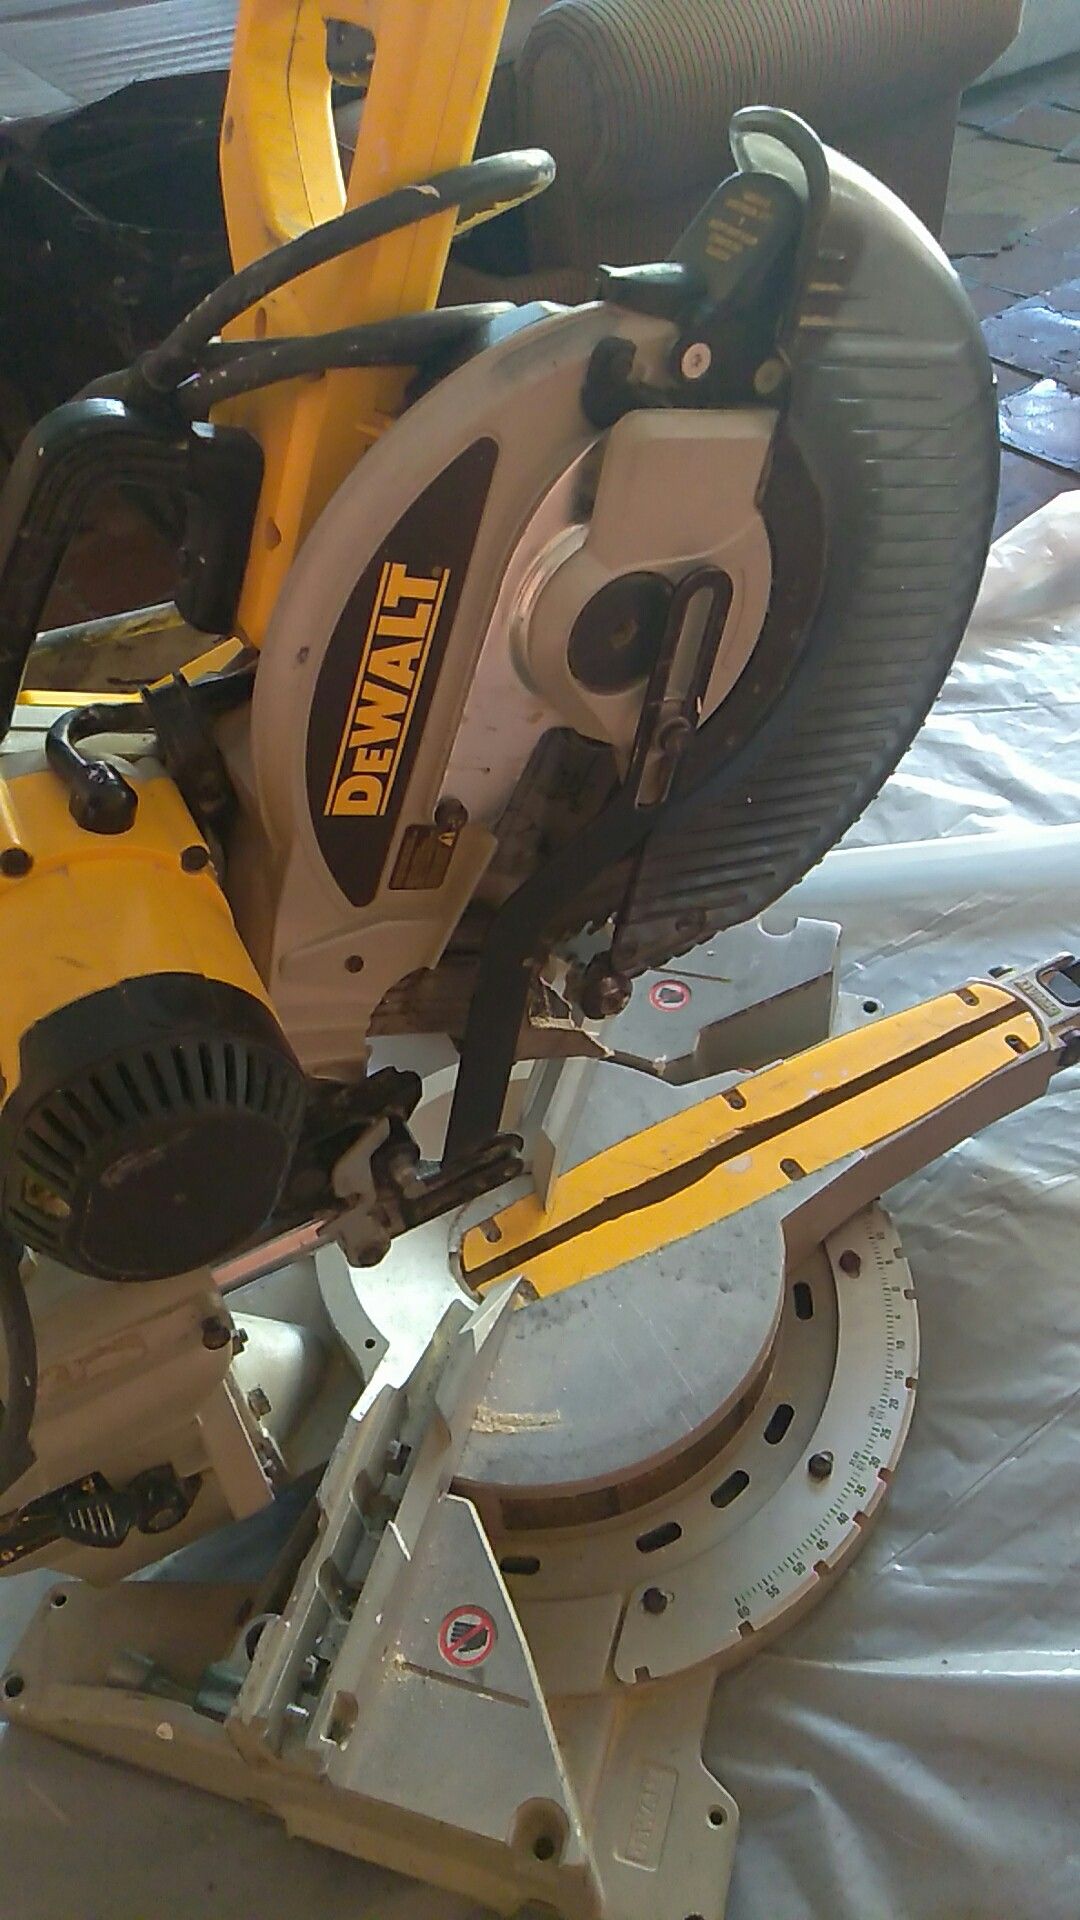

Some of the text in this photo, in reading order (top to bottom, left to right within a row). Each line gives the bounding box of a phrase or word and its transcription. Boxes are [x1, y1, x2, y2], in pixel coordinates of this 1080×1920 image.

[330, 562, 439, 817] DEWALT
[766, 1585, 780, 1598] 55
[793, 1562, 806, 1575] 50
[816, 1539, 828, 1550] 45
[837, 1512, 849, 1525] 40
[854, 1485, 866, 1497] 35
[889, 1398, 899, 1409] 20
